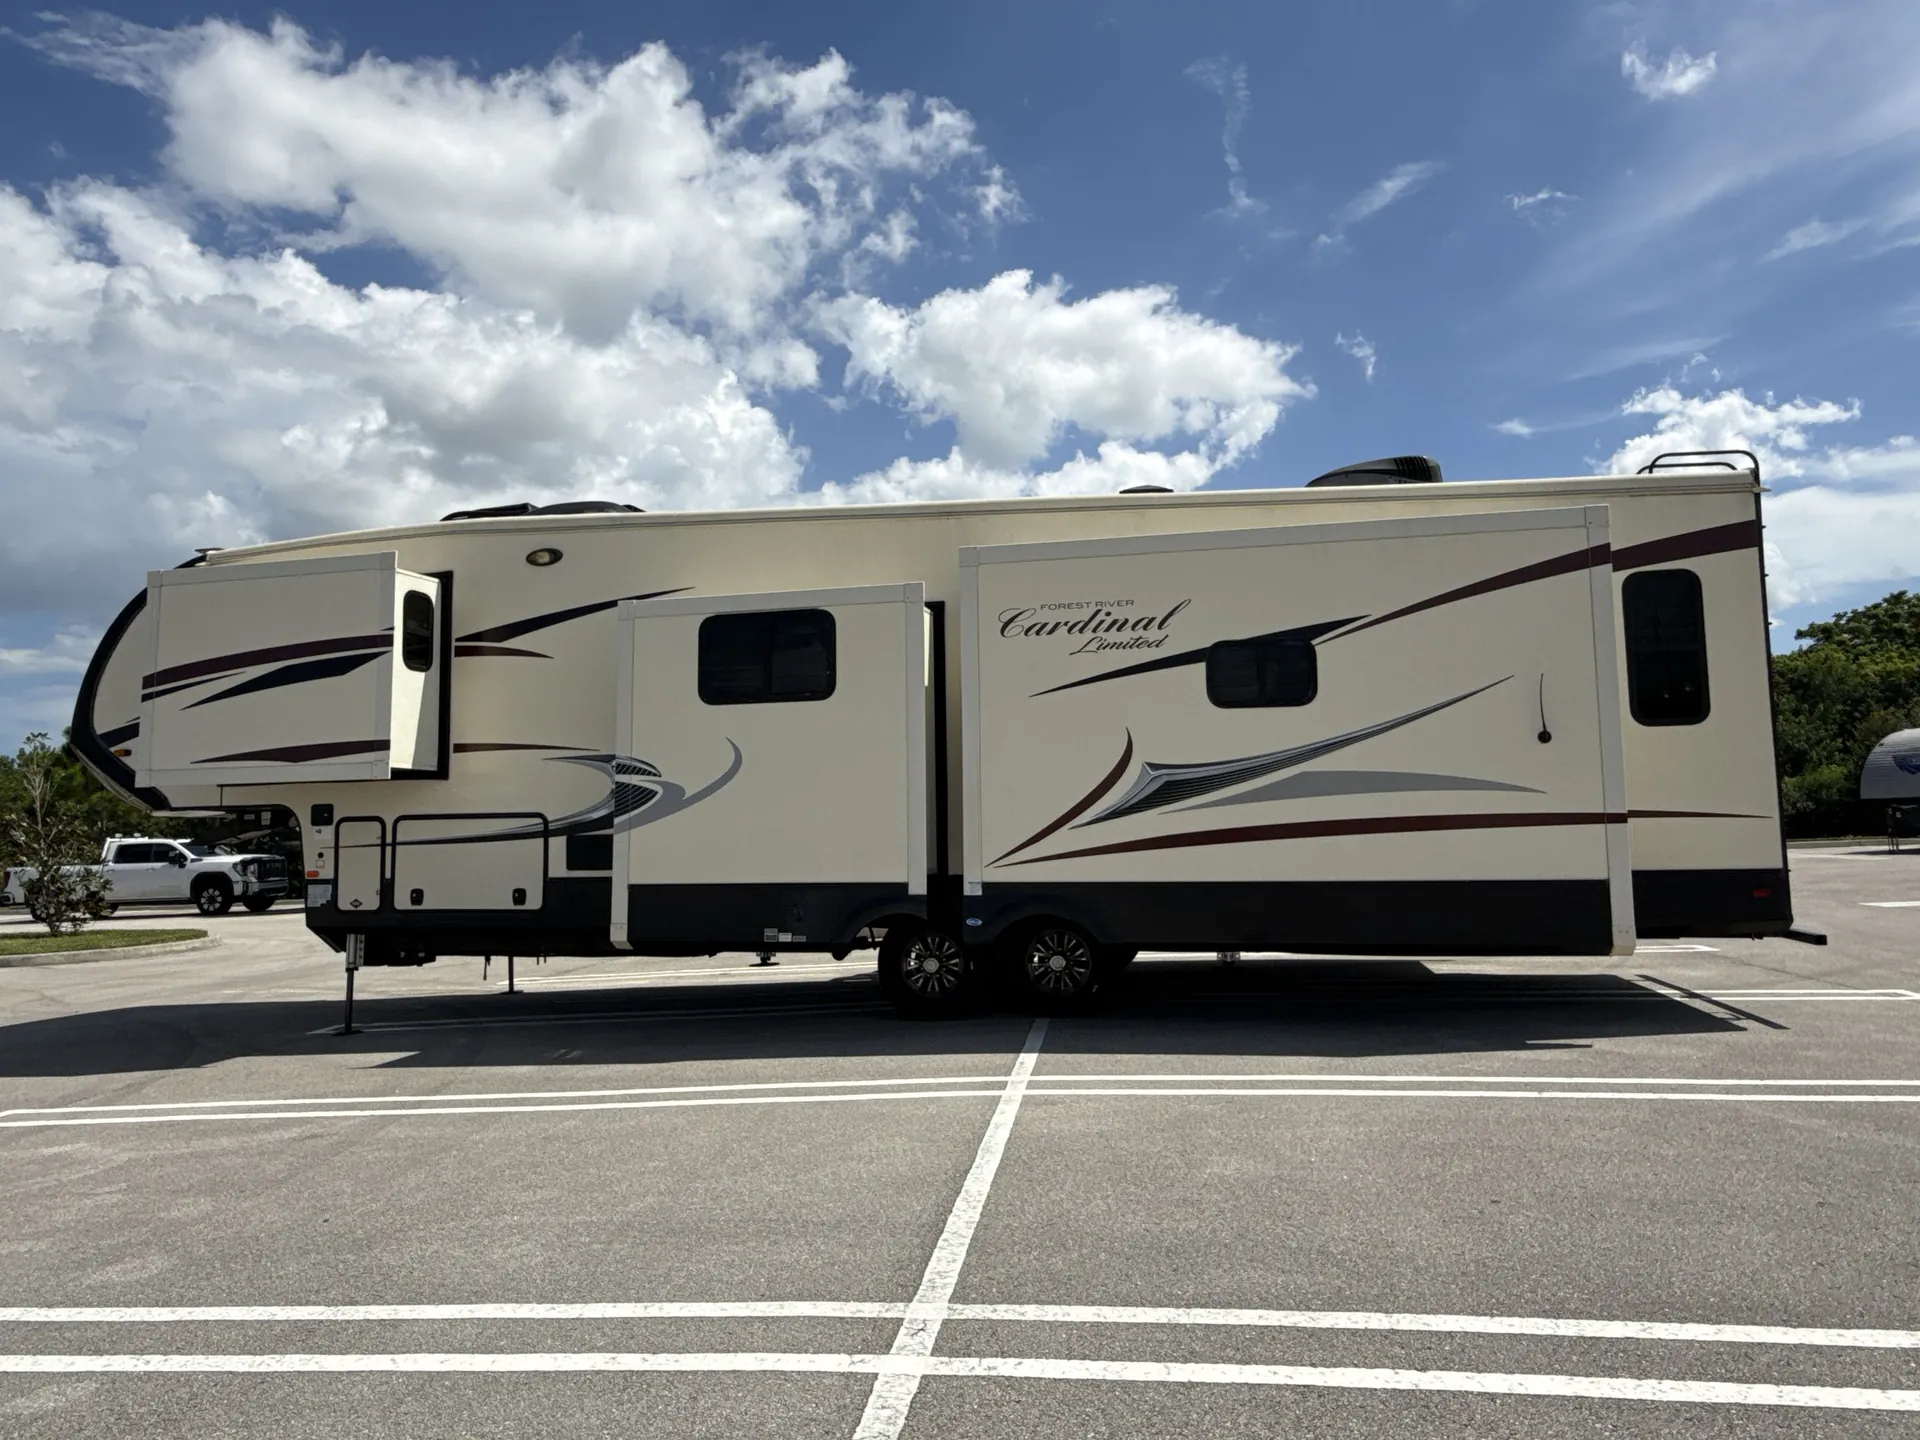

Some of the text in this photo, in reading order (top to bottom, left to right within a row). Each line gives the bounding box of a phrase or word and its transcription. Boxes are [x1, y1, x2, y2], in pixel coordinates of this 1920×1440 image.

[1040, 599, 1135, 611] FOREST RIVER
[998, 599, 1192, 639] Cardinal
[1069, 634, 1169, 656] Limited
